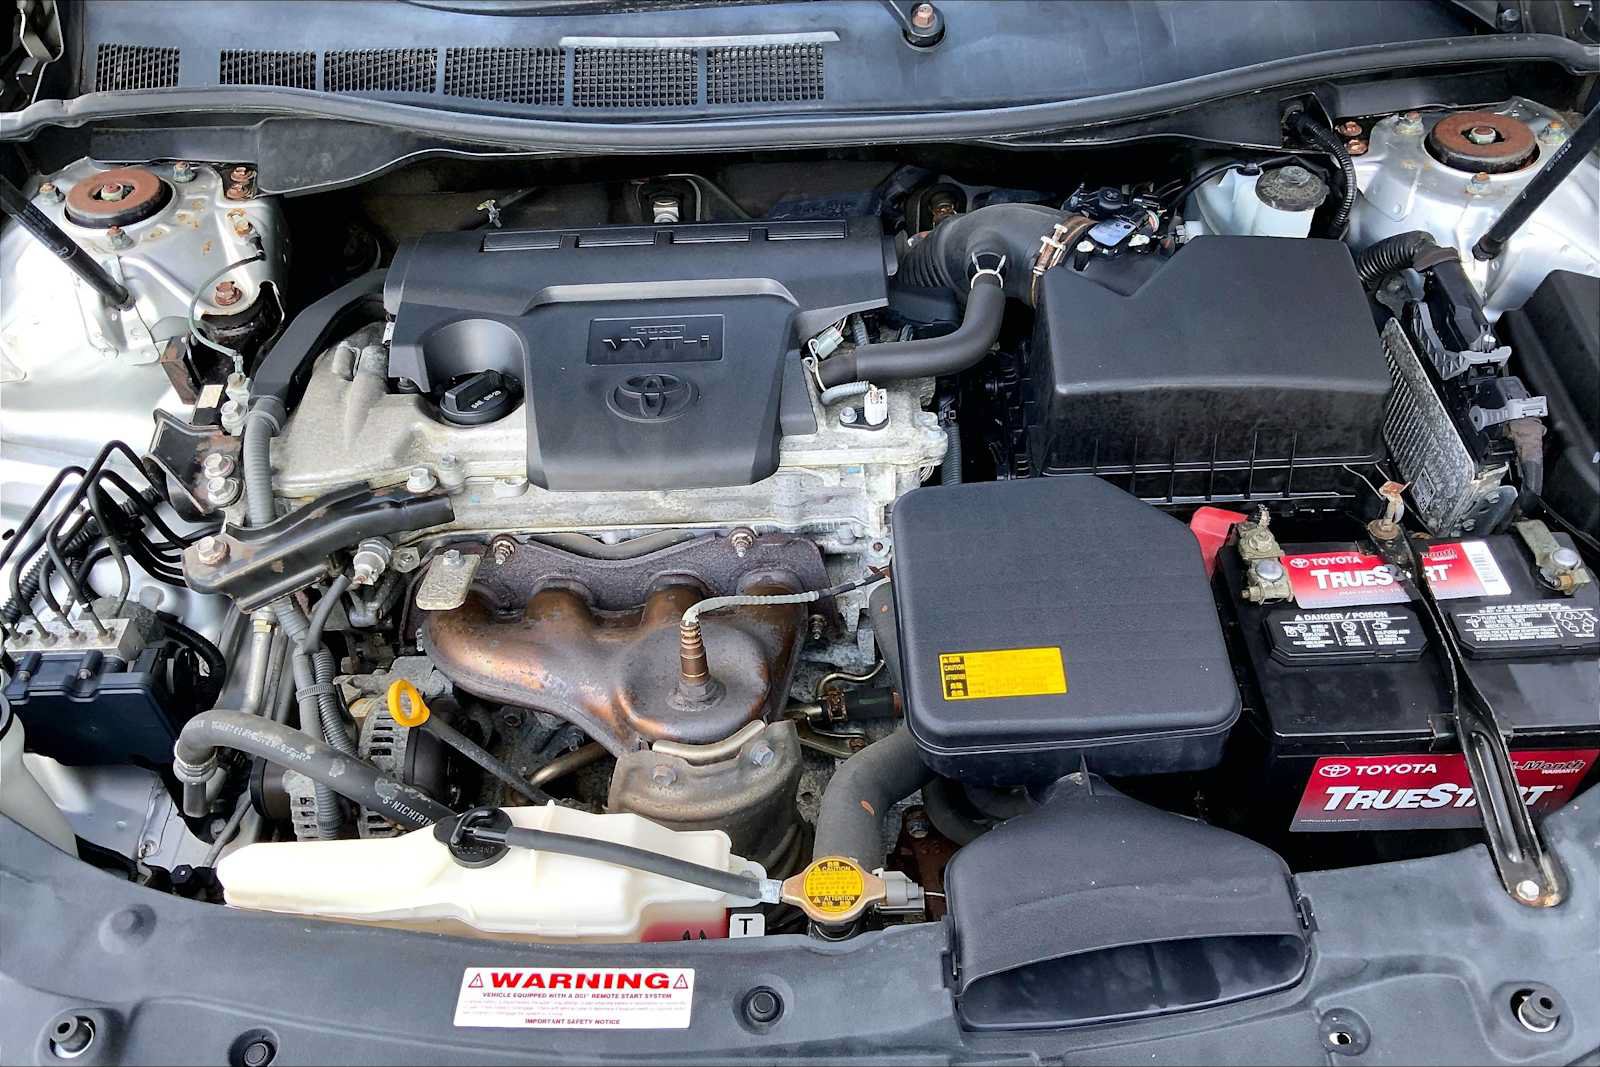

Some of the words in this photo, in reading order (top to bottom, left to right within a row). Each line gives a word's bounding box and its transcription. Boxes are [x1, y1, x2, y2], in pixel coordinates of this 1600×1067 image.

[1310, 555, 1362, 567] TOYOTA
[1304, 613, 1343, 621] DANGER
[1351, 611, 1388, 619] POISON
[1355, 763, 1437, 776] TOYOTA
[491, 973, 669, 989] WARNING
